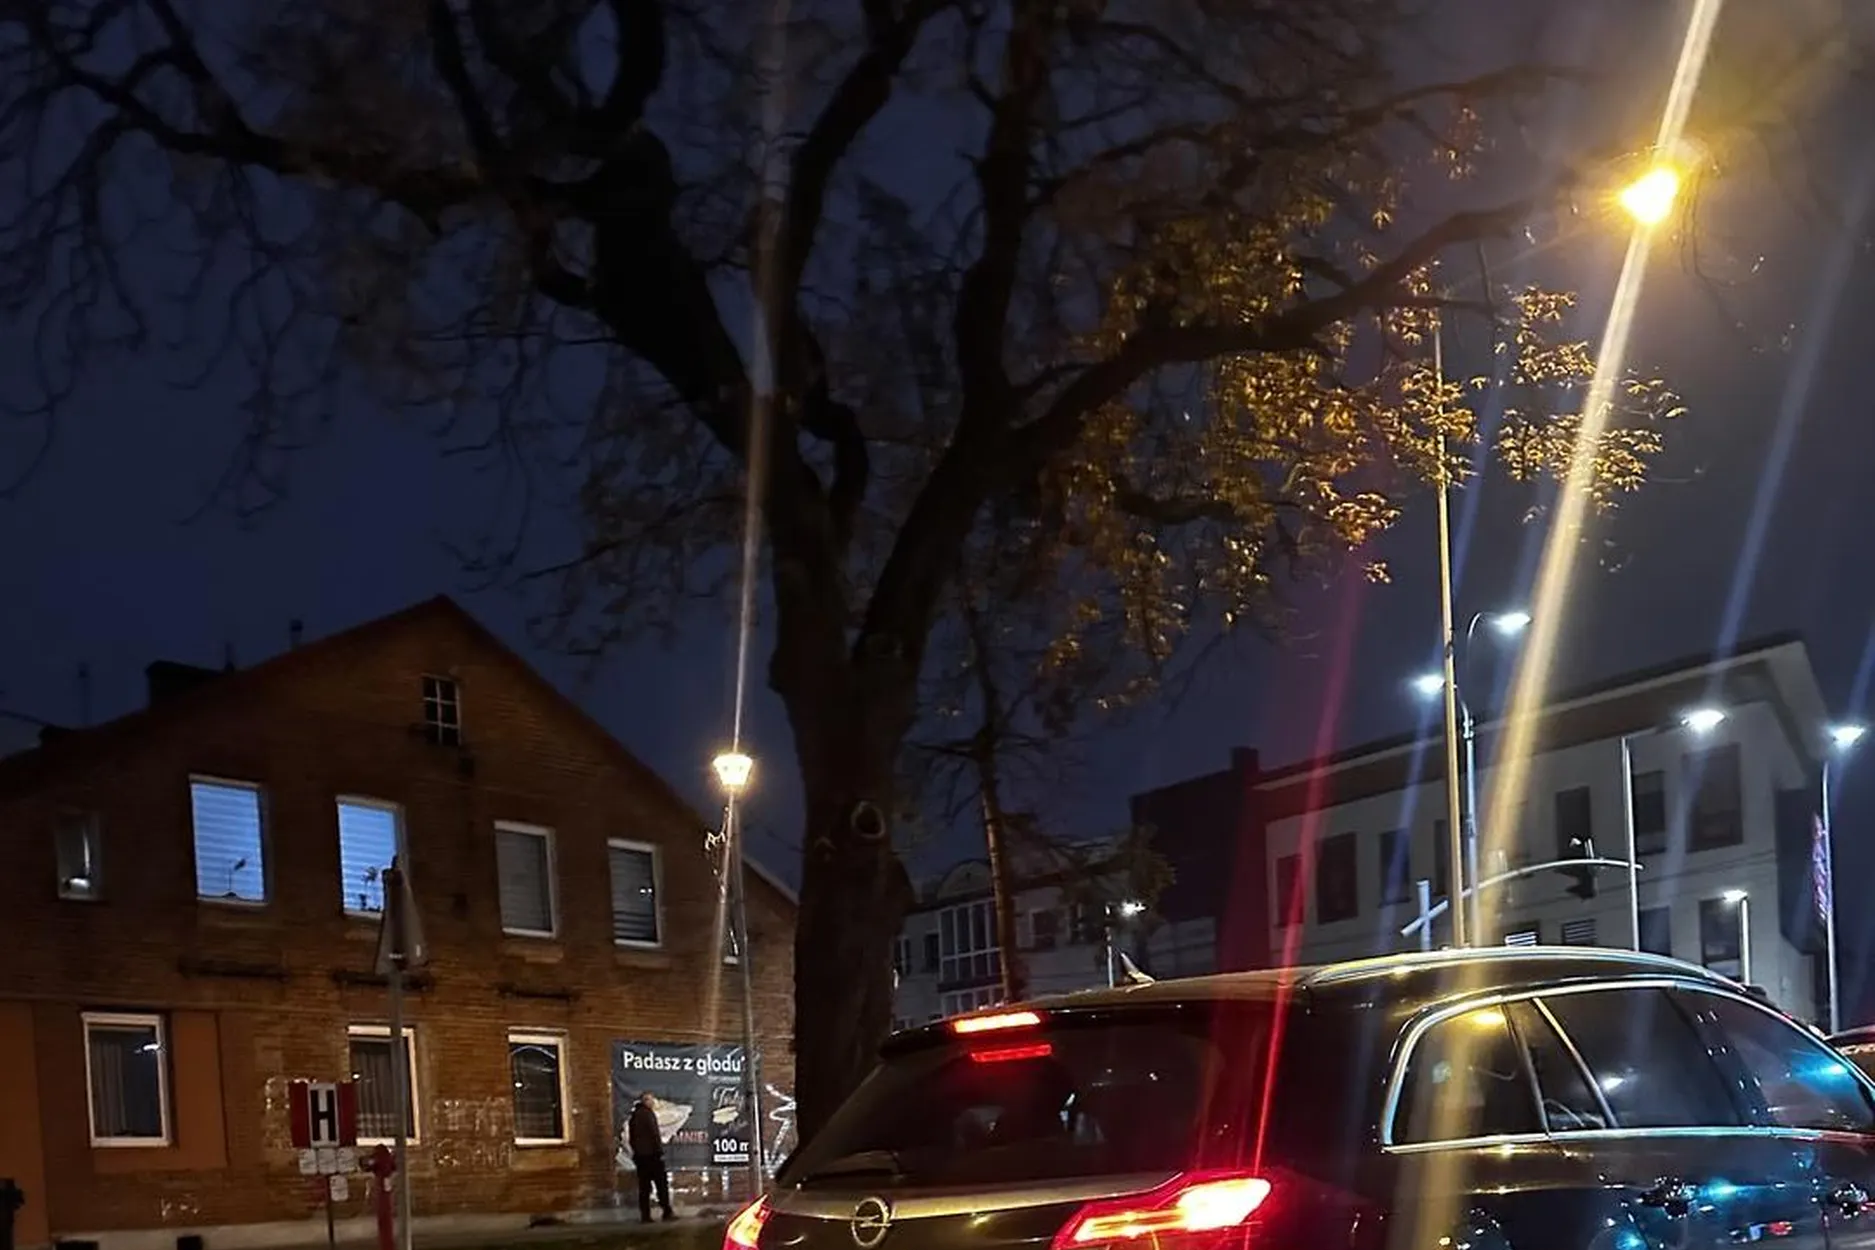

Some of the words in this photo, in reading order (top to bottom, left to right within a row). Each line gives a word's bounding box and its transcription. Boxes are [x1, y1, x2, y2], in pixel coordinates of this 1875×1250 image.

[623, 1051, 680, 1071] Padasz
[683, 1057, 694, 1071] z
[310, 1089, 337, 1142] H
[713, 1138, 738, 1152] 100
